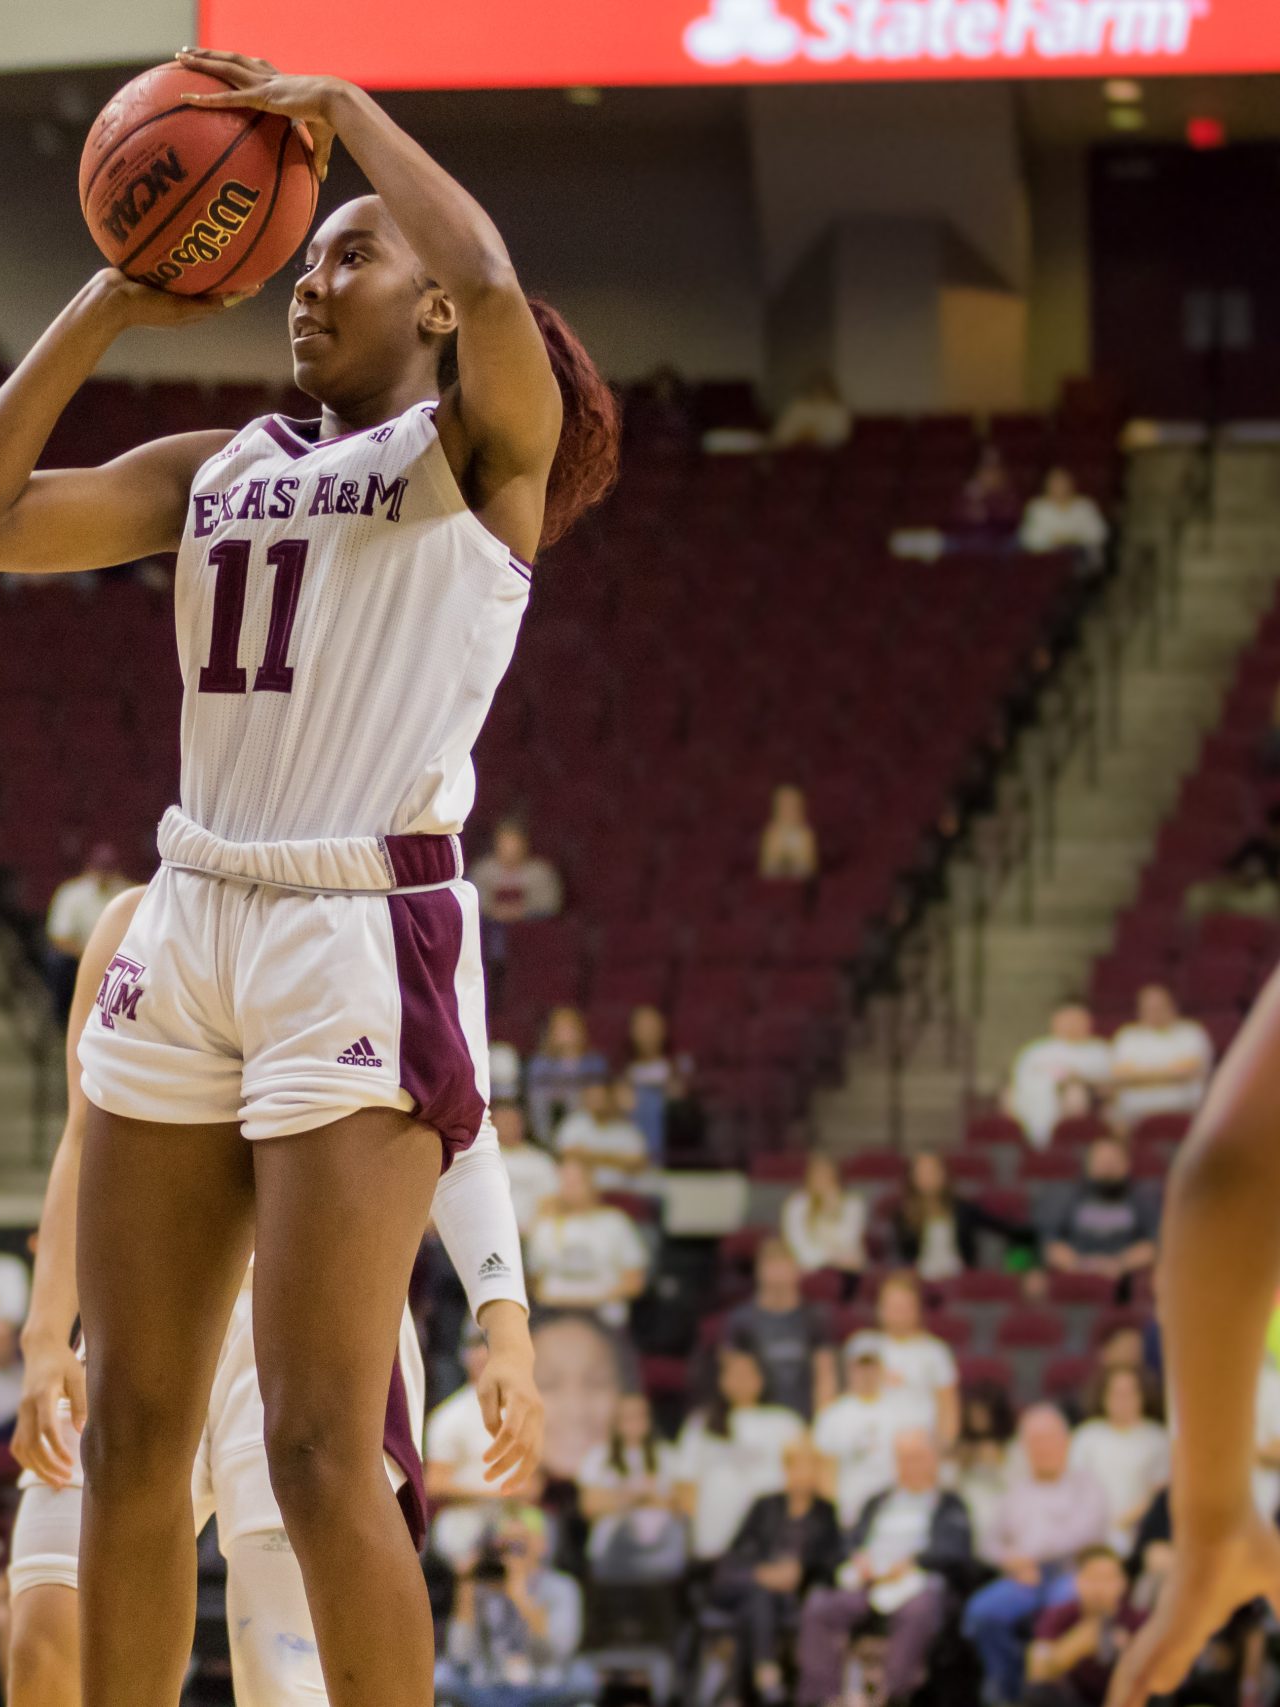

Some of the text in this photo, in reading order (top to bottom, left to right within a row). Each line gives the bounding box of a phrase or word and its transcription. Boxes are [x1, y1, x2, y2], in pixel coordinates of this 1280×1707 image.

[100, 146, 187, 244] NCAA
[137, 179, 262, 285] Wilson
[193, 472, 408, 538] EXAS A&M
[198, 539, 309, 693] 11
[337, 1055, 382, 1067] adidas
[478, 1263, 511, 1276] adidas
